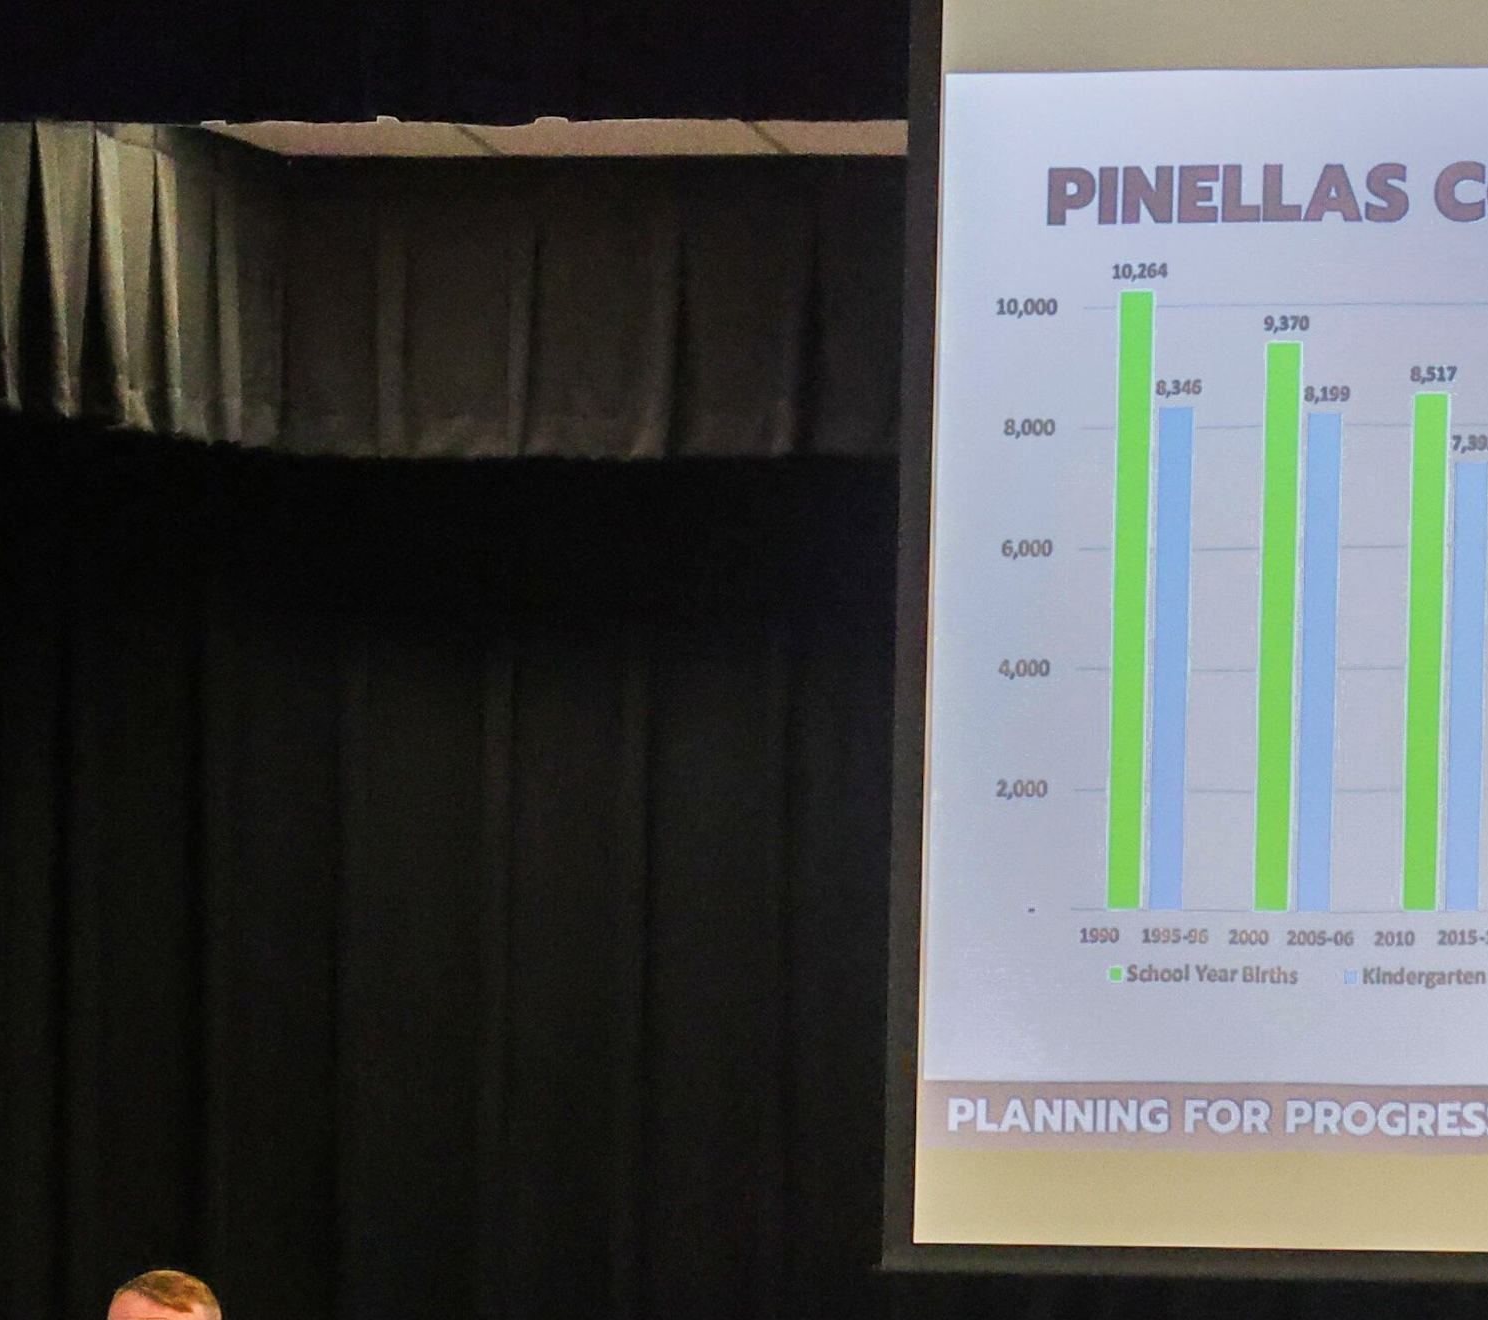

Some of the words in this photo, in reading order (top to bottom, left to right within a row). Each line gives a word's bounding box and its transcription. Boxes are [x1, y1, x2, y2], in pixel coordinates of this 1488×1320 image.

[1047, 162, 1410, 226] PINELLAS
[1113, 262, 1168, 282] 10,264
[996, 298, 1058, 319] 10,000
[1264, 315, 1310, 334] 9,370
[1410, 366, 1457, 385] 8,517
[1156, 379, 1202, 398] 8,346
[1304, 385, 1351, 404] 8,199
[1003, 418, 1056, 439] 8,000
[1001, 539, 1053, 560] 6,000
[998, 659, 1051, 680] 4,000
[996, 779, 1048, 800] 2,000
[1080, 927, 1120, 944] 1990
[1142, 928, 1208, 944] 1995-96
[1228, 929, 1269, 946] 2000
[1286, 930, 1354, 947] 2005-06
[1374, 930, 1415, 947] 2010
[1127, 964, 1190, 983] School
[1195, 964, 1238, 983] Year
[1242, 965, 1298, 985] Births
[1362, 966, 1486, 989] Kindergarten
[947, 1098, 1167, 1133] PLANNING
[1185, 1100, 1269, 1134] FOR
